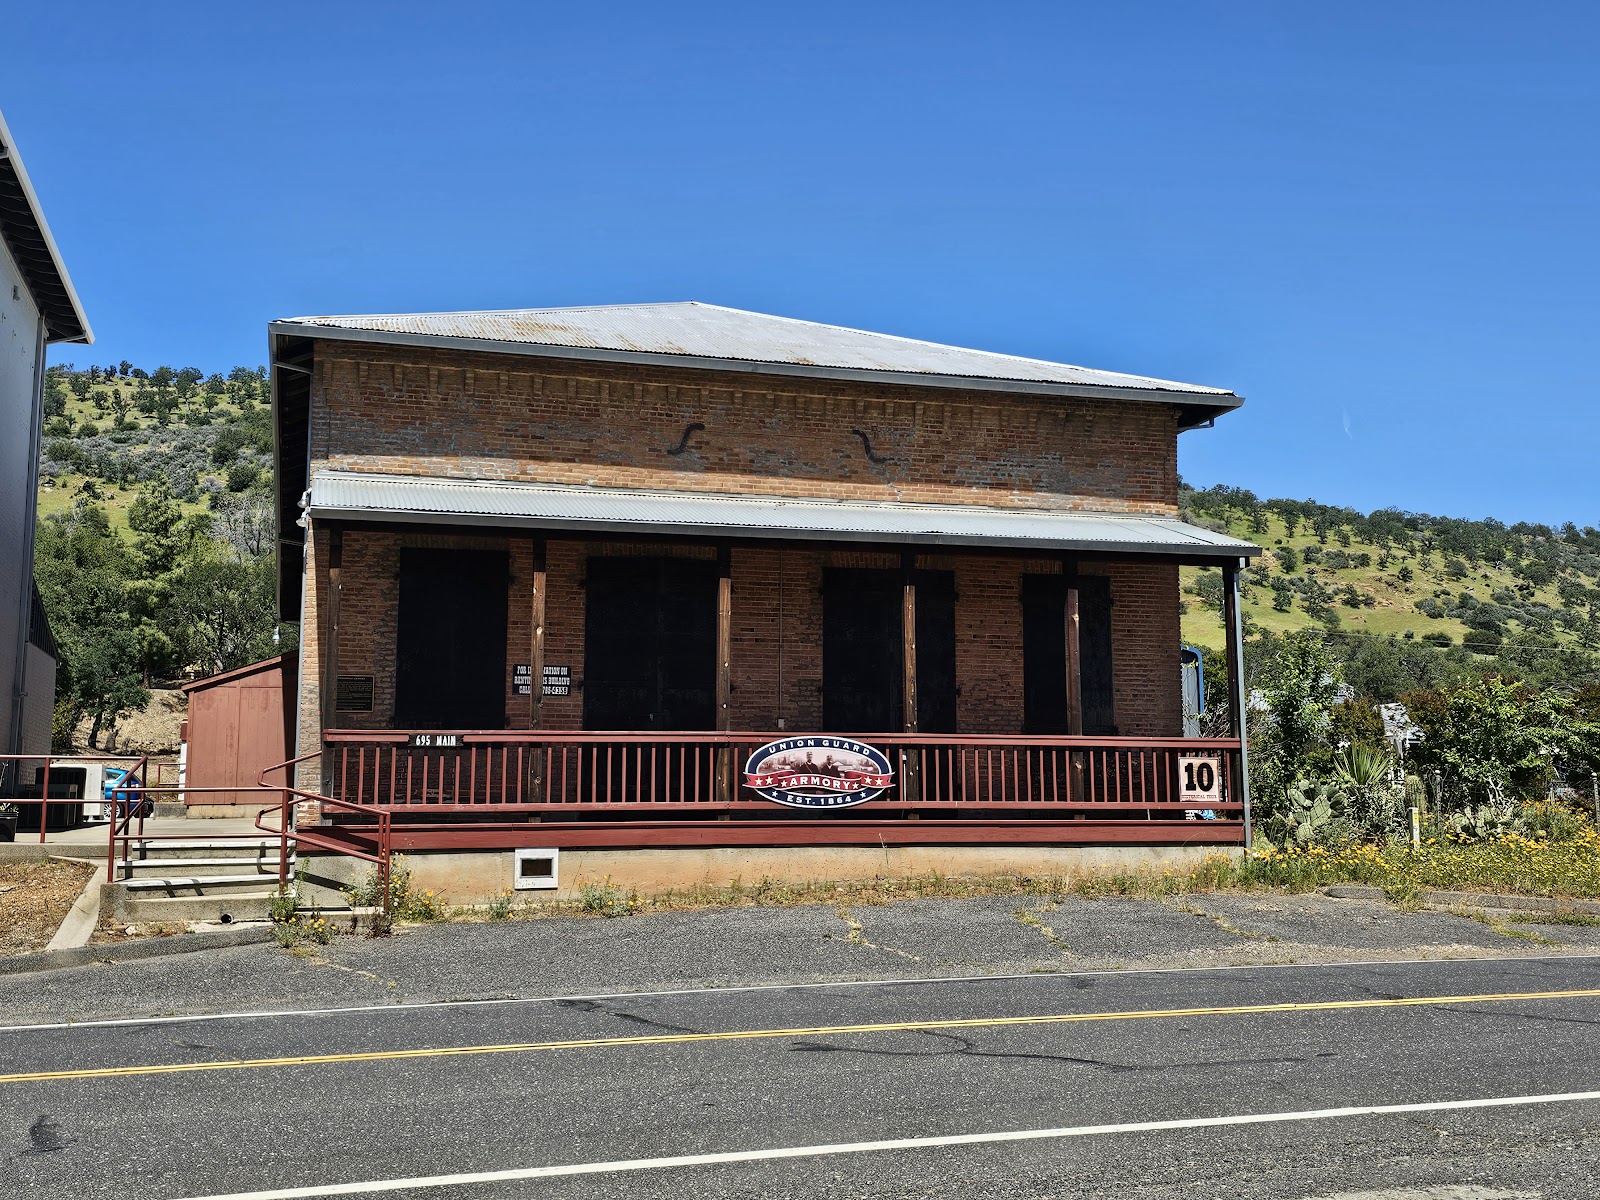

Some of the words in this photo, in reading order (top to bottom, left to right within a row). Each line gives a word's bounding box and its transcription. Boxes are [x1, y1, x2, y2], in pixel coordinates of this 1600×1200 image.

[415, 734, 431, 746] 695
[436, 735, 456, 747] MAIN
[768, 739, 815, 754] UNION
[822, 739, 870, 756] GUARD
[789, 776, 852, 790] ARMORY
[1185, 762, 1214, 792] 10
[786, 794, 816, 805] EST.
[820, 794, 852, 805] 1864
